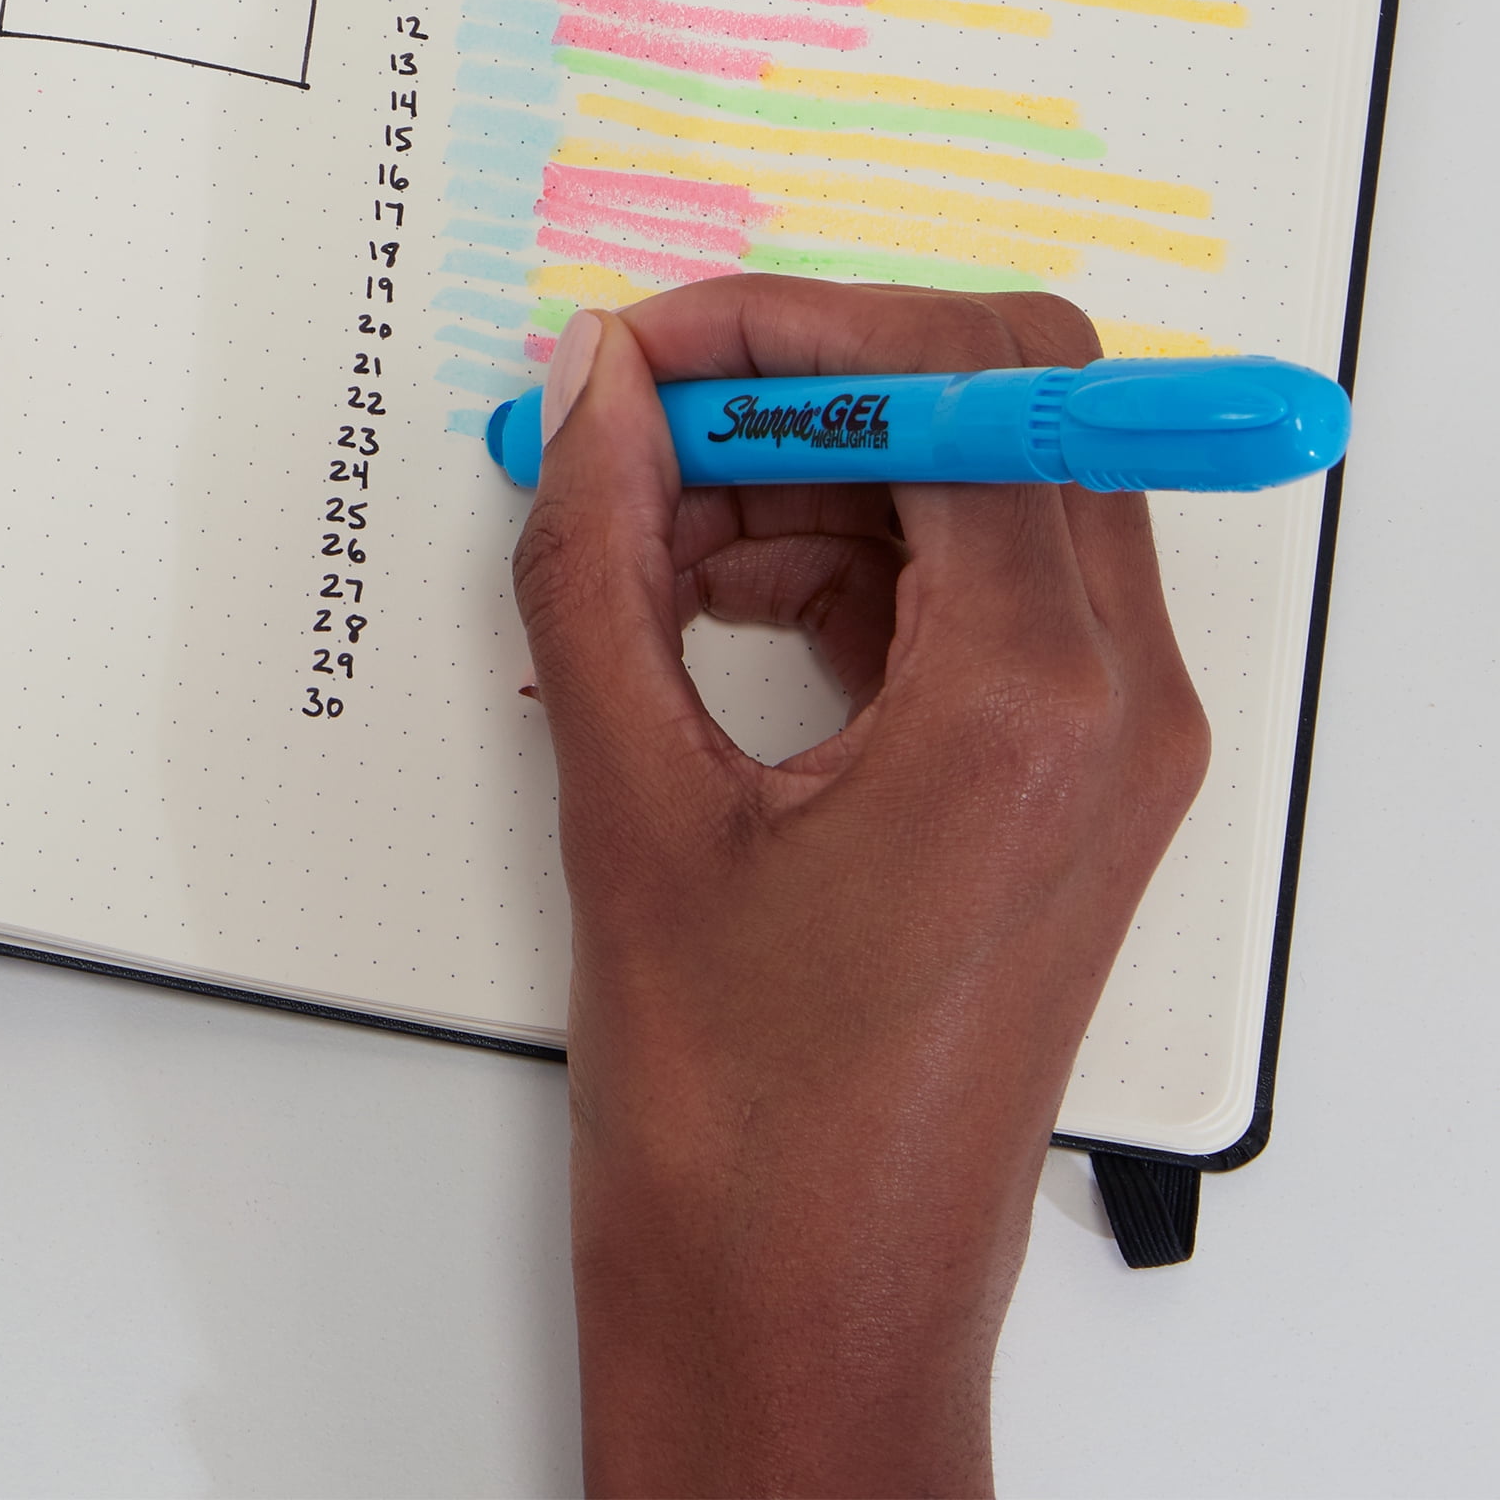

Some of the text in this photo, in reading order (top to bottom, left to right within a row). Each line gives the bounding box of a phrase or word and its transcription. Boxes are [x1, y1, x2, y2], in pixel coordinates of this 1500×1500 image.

[396, 16, 429, 41] 12
[390, 52, 418, 76] 13
[391, 90, 418, 120] 14
[385, 124, 413, 153] 15
[378, 163, 410, 191] 16
[374, 199, 405, 227] 17
[369, 240, 400, 269] 18
[366, 275, 394, 303] 19
[358, 314, 393, 341] 20
[353, 352, 382, 378] 21
[347, 385, 387, 416] 22
[821, 394, 889, 431] GEL
[337, 425, 380, 456] 23
[811, 429, 889, 449] HIGHLIGHTER
[329, 460, 369, 490] 24
[325, 497, 368, 530] 25
[321, 533, 367, 564] 26
[319, 573, 364, 604] 27
[312, 609, 368, 644] 28
[312, 648, 354, 679] 29
[301, 687, 344, 718] 30
